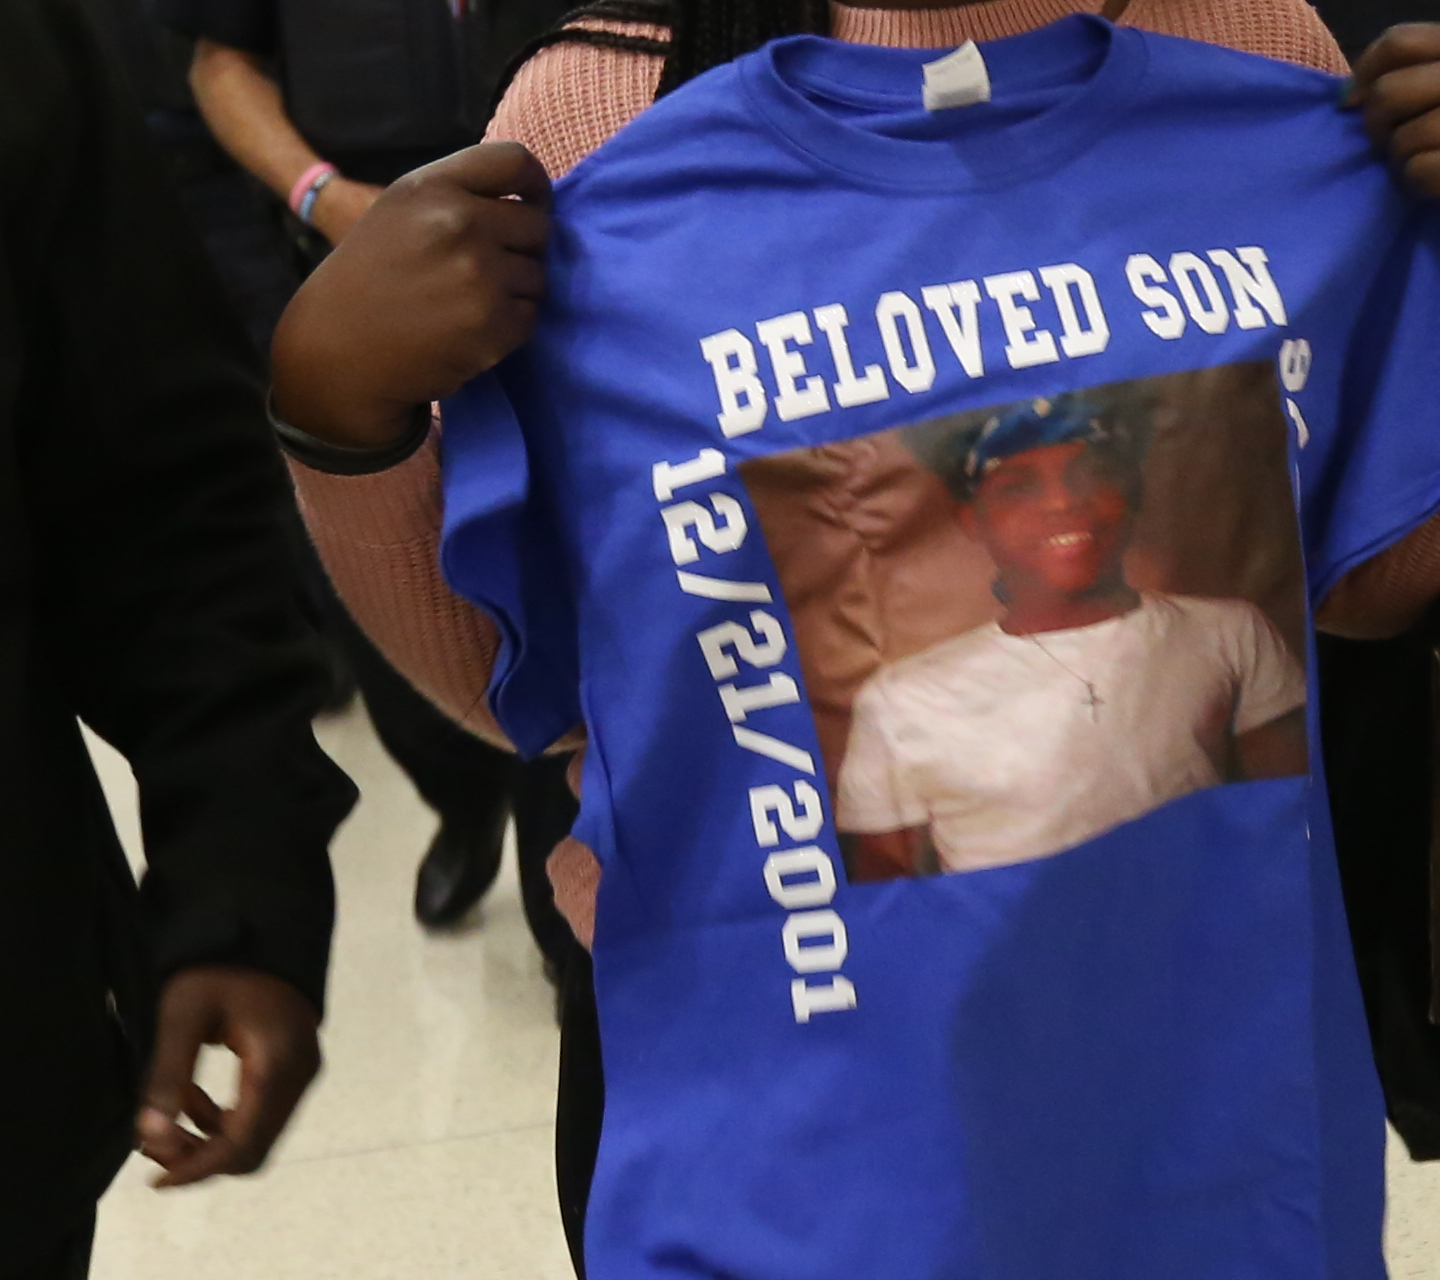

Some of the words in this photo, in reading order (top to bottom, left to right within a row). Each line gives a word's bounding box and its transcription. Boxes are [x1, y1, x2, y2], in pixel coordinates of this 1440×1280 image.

[699, 262, 1112, 440] BELOVED
[1124, 245, 1288, 340] SON
[652, 447, 858, 1024] 12/21/2001
